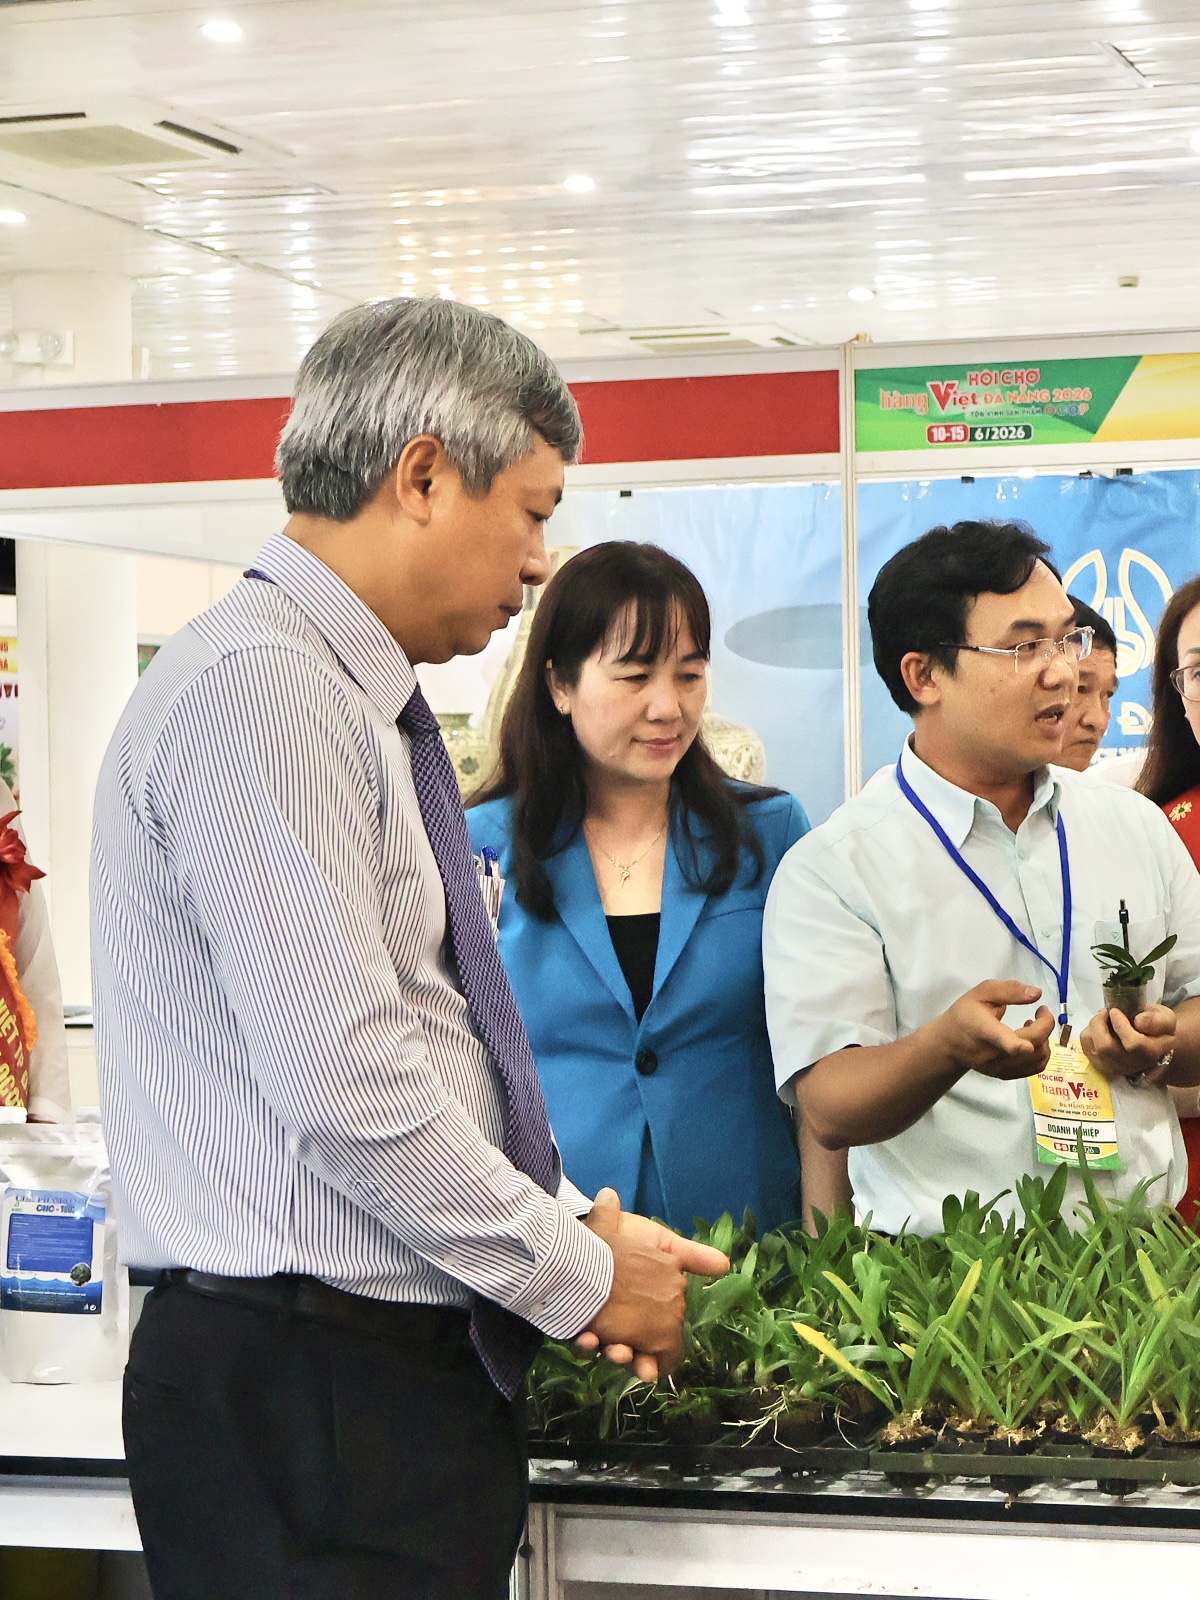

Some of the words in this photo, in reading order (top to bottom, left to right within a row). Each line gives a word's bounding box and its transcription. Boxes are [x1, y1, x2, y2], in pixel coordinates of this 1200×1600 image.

[929, 381, 978, 413] Việt
[1053, 387, 1092, 402] 2026
[931, 425, 965, 442] 10-15
[974, 425, 1026, 442] 6/2026
[1047, 1123, 1071, 1135] DOANH
[1073, 1126, 1100, 1139] NHIỆP
